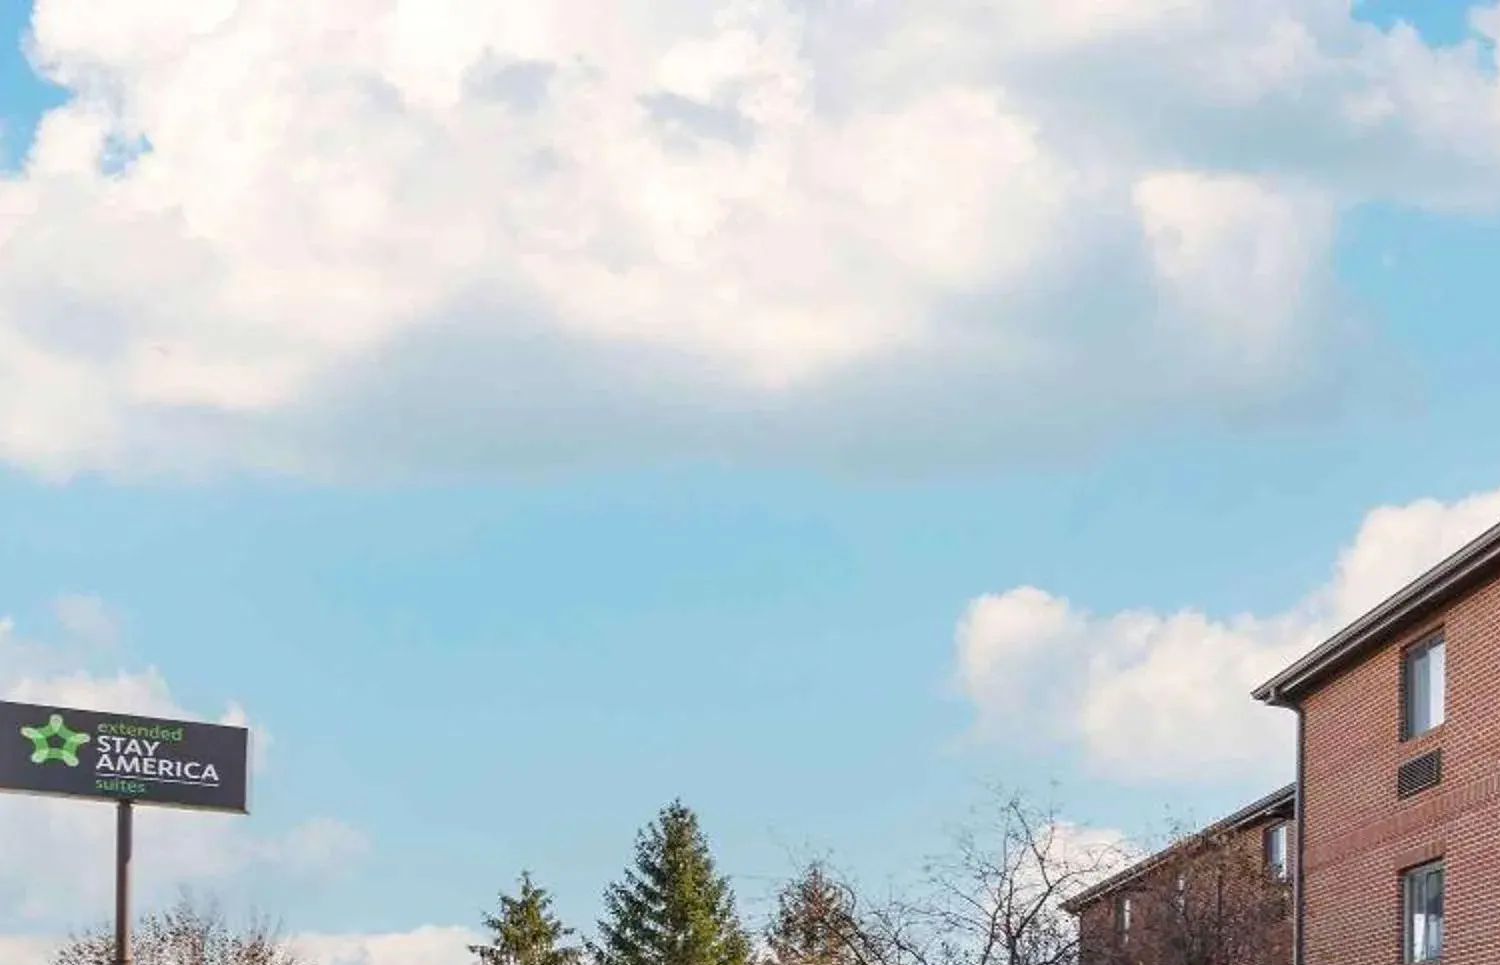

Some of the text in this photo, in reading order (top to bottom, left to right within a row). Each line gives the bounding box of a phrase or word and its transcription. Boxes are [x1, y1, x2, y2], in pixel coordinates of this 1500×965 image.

[97, 722, 184, 742] extended
[96, 735, 160, 757] STAY
[95, 753, 219, 781] AMERICA
[95, 779, 146, 794] suites
